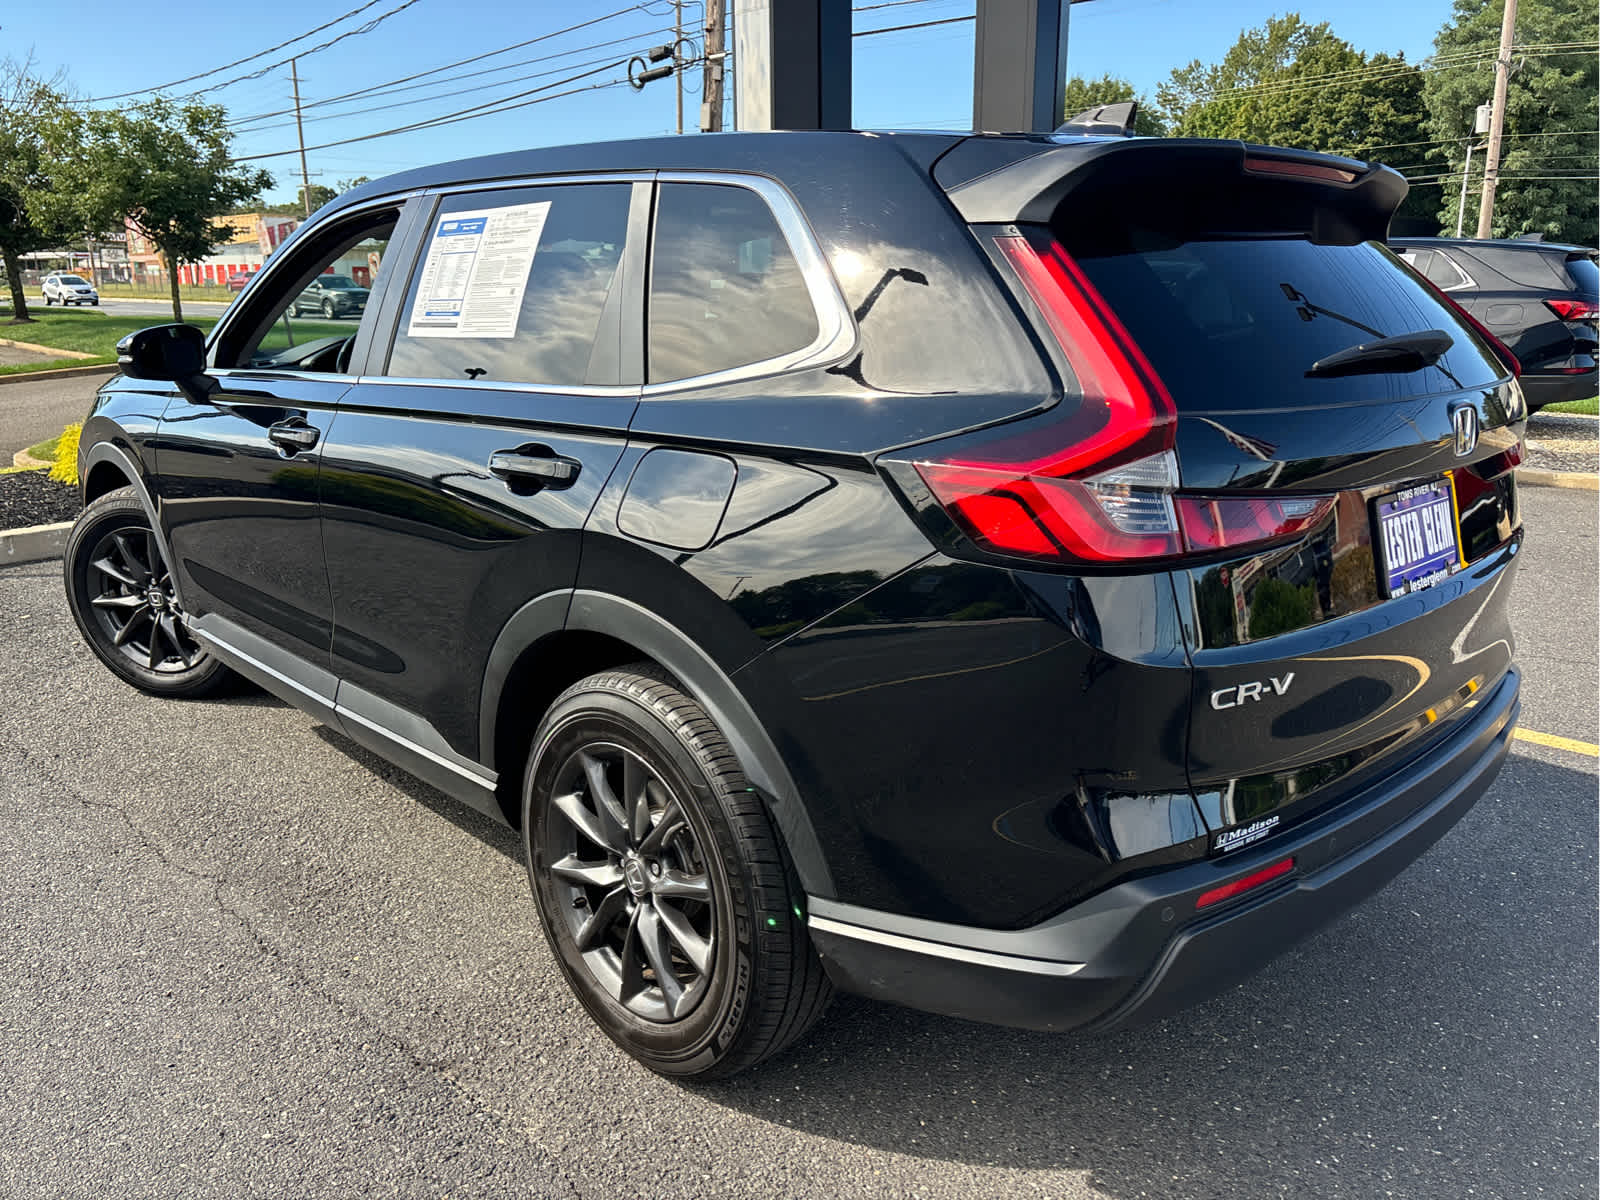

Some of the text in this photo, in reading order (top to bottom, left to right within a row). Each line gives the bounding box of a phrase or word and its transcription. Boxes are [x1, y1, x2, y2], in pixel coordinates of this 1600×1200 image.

[1382, 500, 1455, 571] LESTER GLENN
[1211, 672, 1295, 710] CR-V
[1228, 815, 1280, 841] Madison
